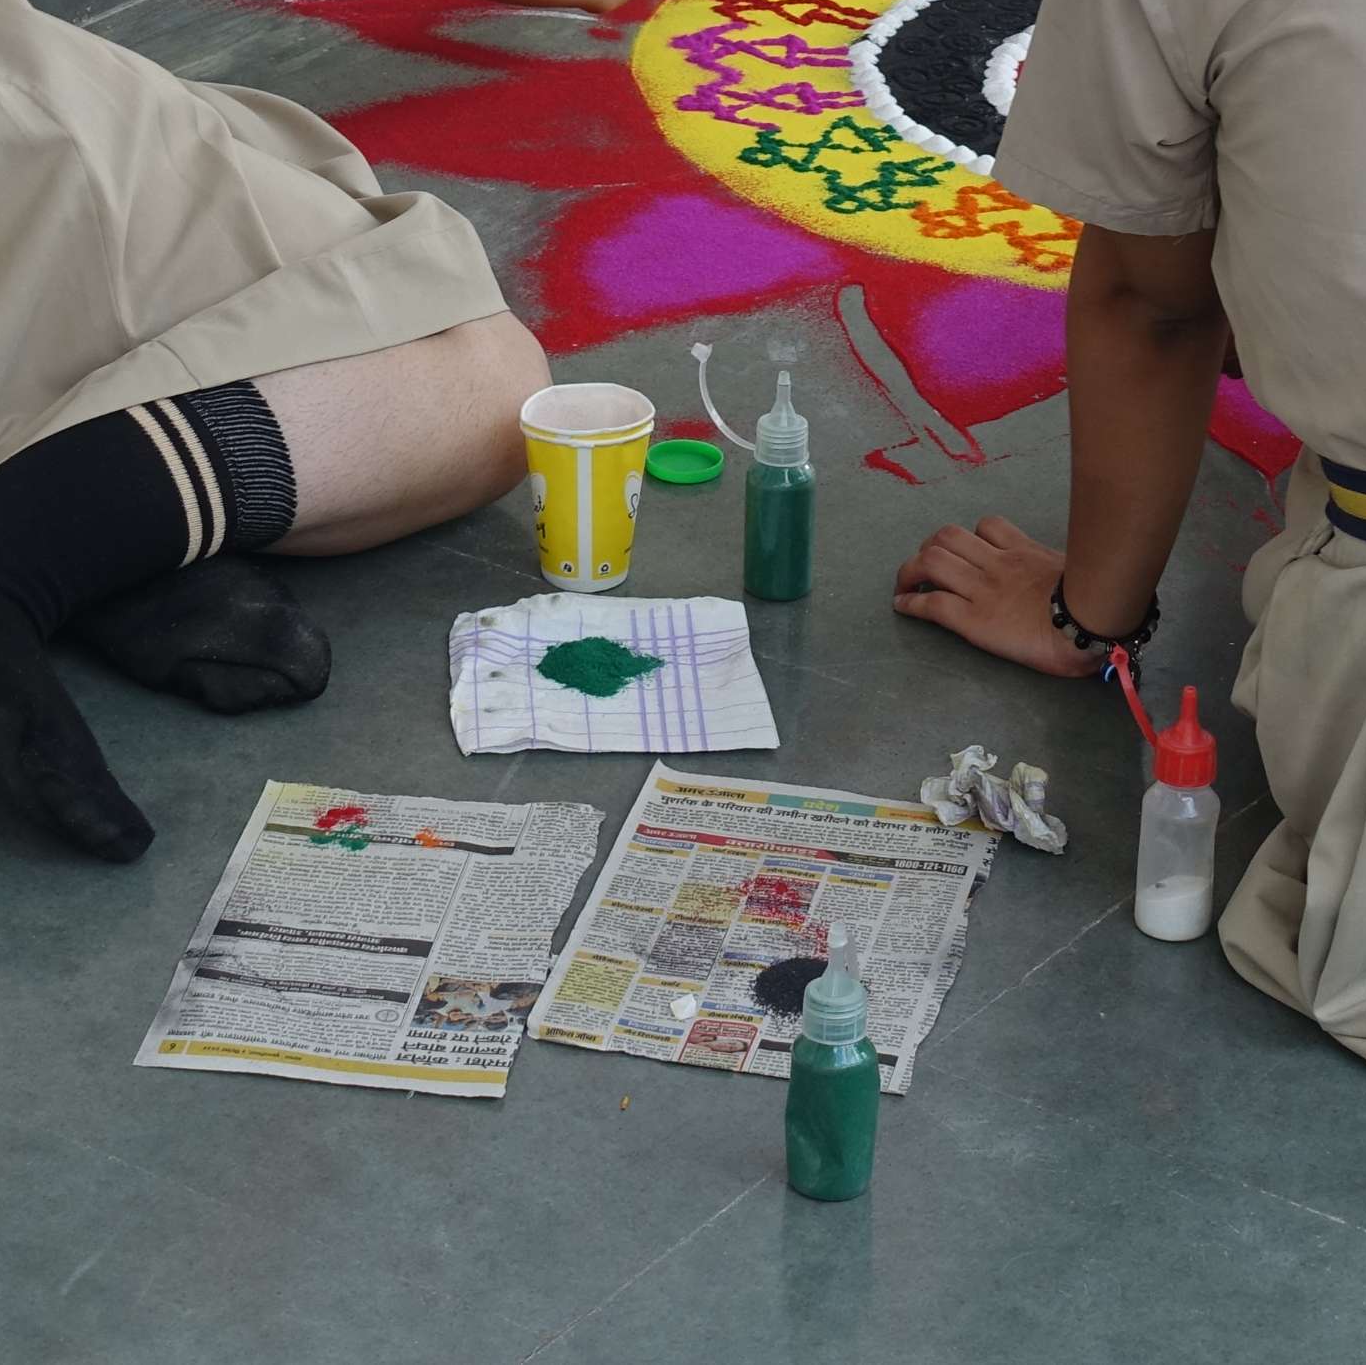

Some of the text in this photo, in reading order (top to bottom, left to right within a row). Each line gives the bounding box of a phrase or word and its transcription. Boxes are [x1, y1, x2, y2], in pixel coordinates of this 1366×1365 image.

[700, 798, 714, 808] के
[716, 801, 753, 814] परिवार
[755, 804, 774, 817] की
[775, 807, 809, 821] जमीन
[810, 812, 850, 826] खरीदने
[853, 817, 869, 828] को
[872, 819, 907, 833] देशभर
[909, 823, 924, 833] के
[925, 825, 950, 837] लोग
[406, 1029, 513, 1046] रोकने पर हंगामा
[401, 1041, 508, 1057] कलावा बांधने
[394, 1052, 451, 1068] कॉलेज
